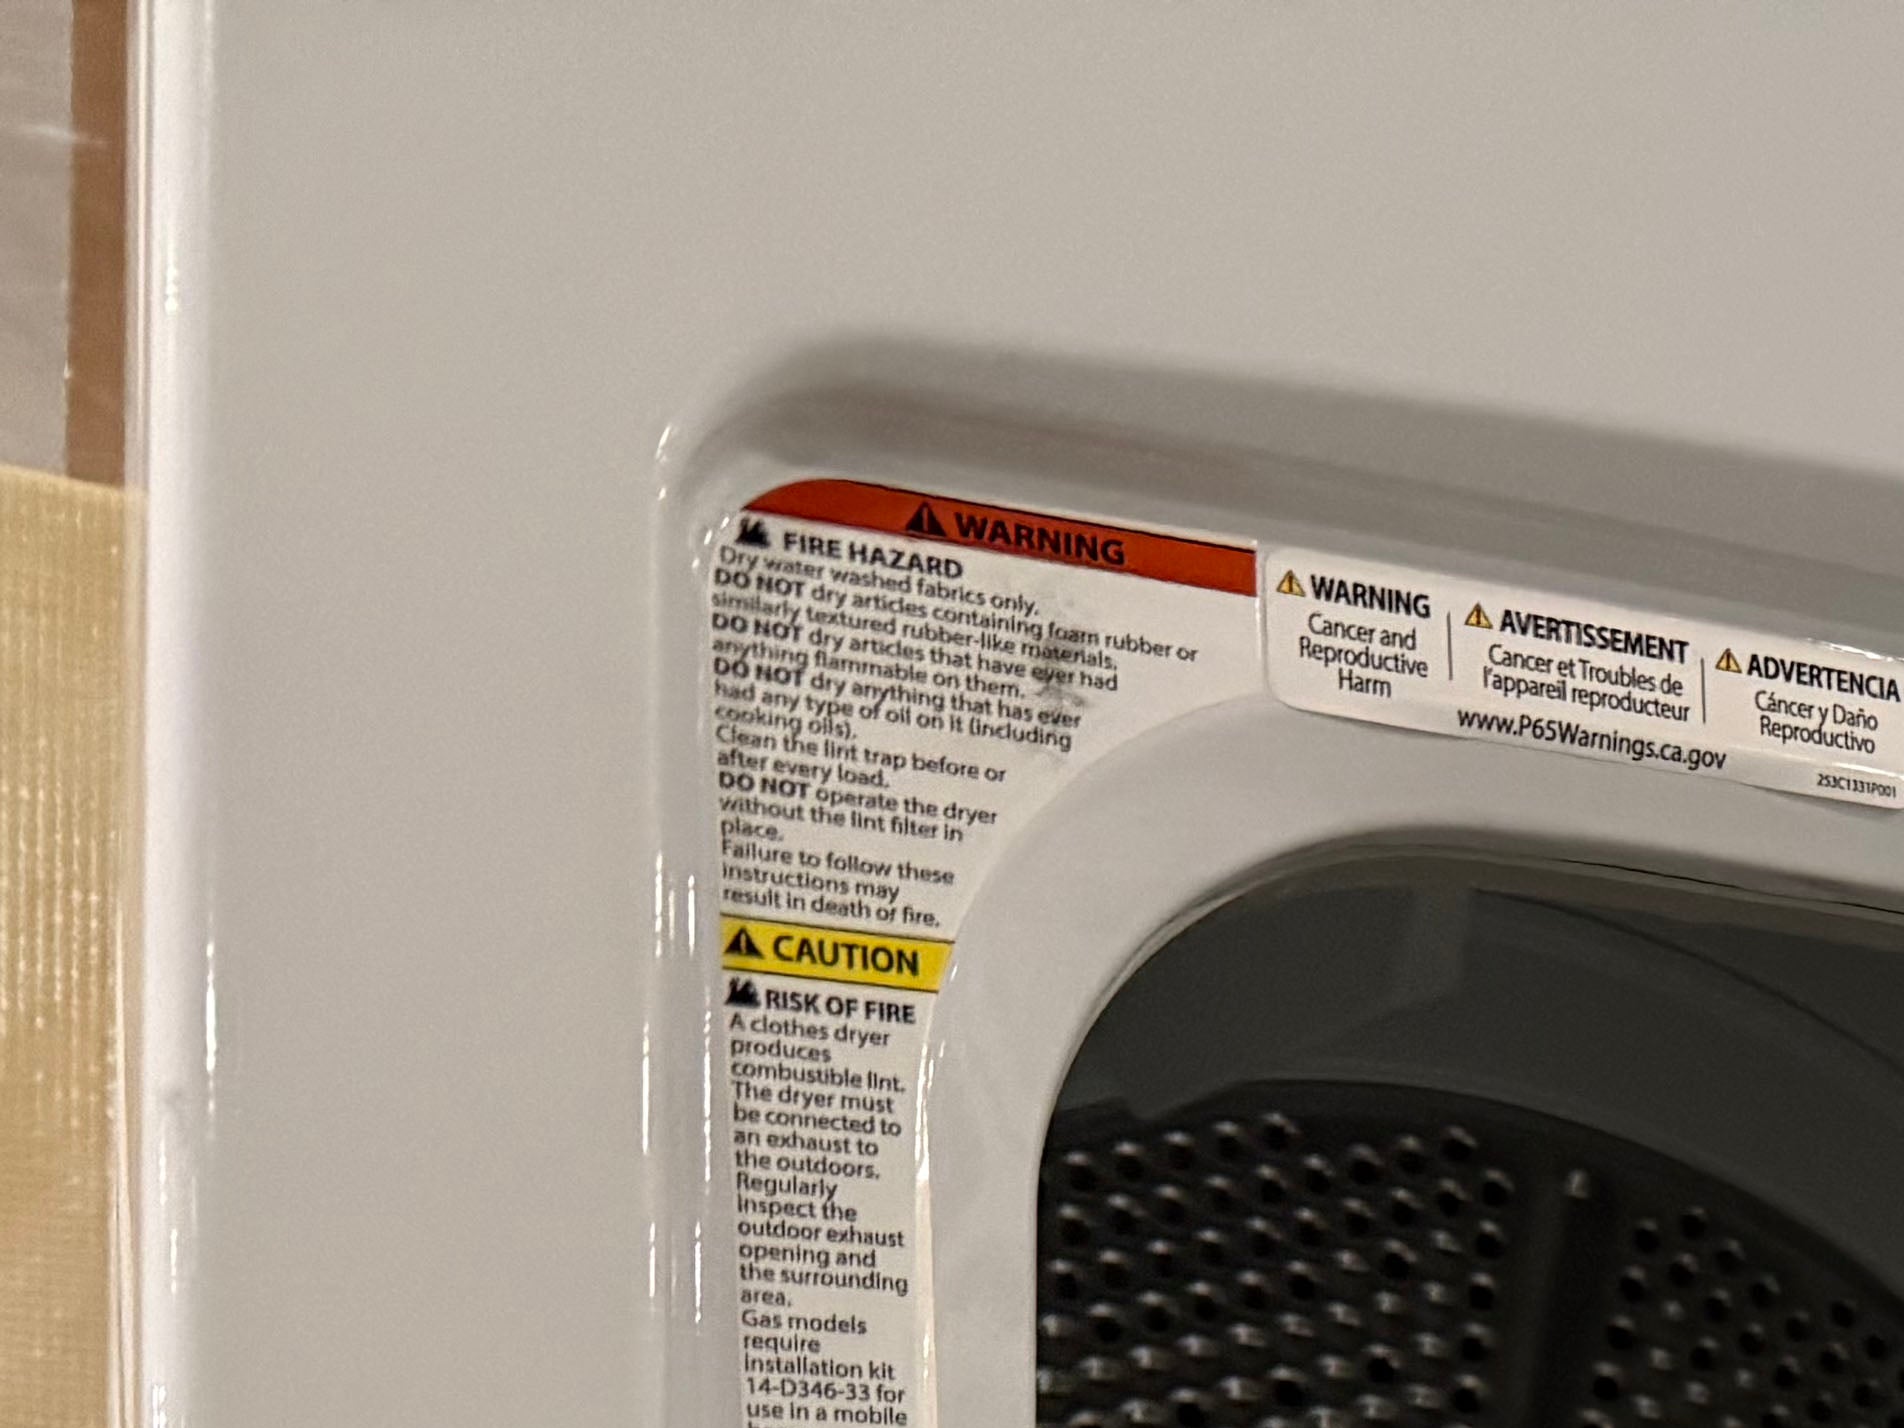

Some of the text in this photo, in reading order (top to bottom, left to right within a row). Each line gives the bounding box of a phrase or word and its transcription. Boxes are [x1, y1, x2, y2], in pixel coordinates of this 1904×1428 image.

[783, 532, 962, 578] FIRE HAZARD
[954, 512, 1125, 565] WARNING
[720, 545, 1038, 615] Dry water washed fabrics only.
[1311, 574, 1430, 619] WARNING
[1308, 613, 1417, 652] Cancer and
[1500, 608, 1689, 666] AVERTISSEMENT
[1299, 636, 1428, 679] Reproductive
[1489, 643, 1683, 697] Cancer et Troubles de
[1747, 654, 1900, 702] ADVERTENCIA
[1339, 669, 1392, 699] Harm
[1483, 666, 1689, 724] l'appareil reproducteur
[1754, 689, 1878, 733] Cáncer y Daño
[1458, 708, 1726, 773] www.P65Warnings.ca.gov
[1760, 715, 1876, 756] Reproductivo
[772, 935, 920, 978] CAUTION
[765, 989, 916, 1024] RISK OF FIRE
